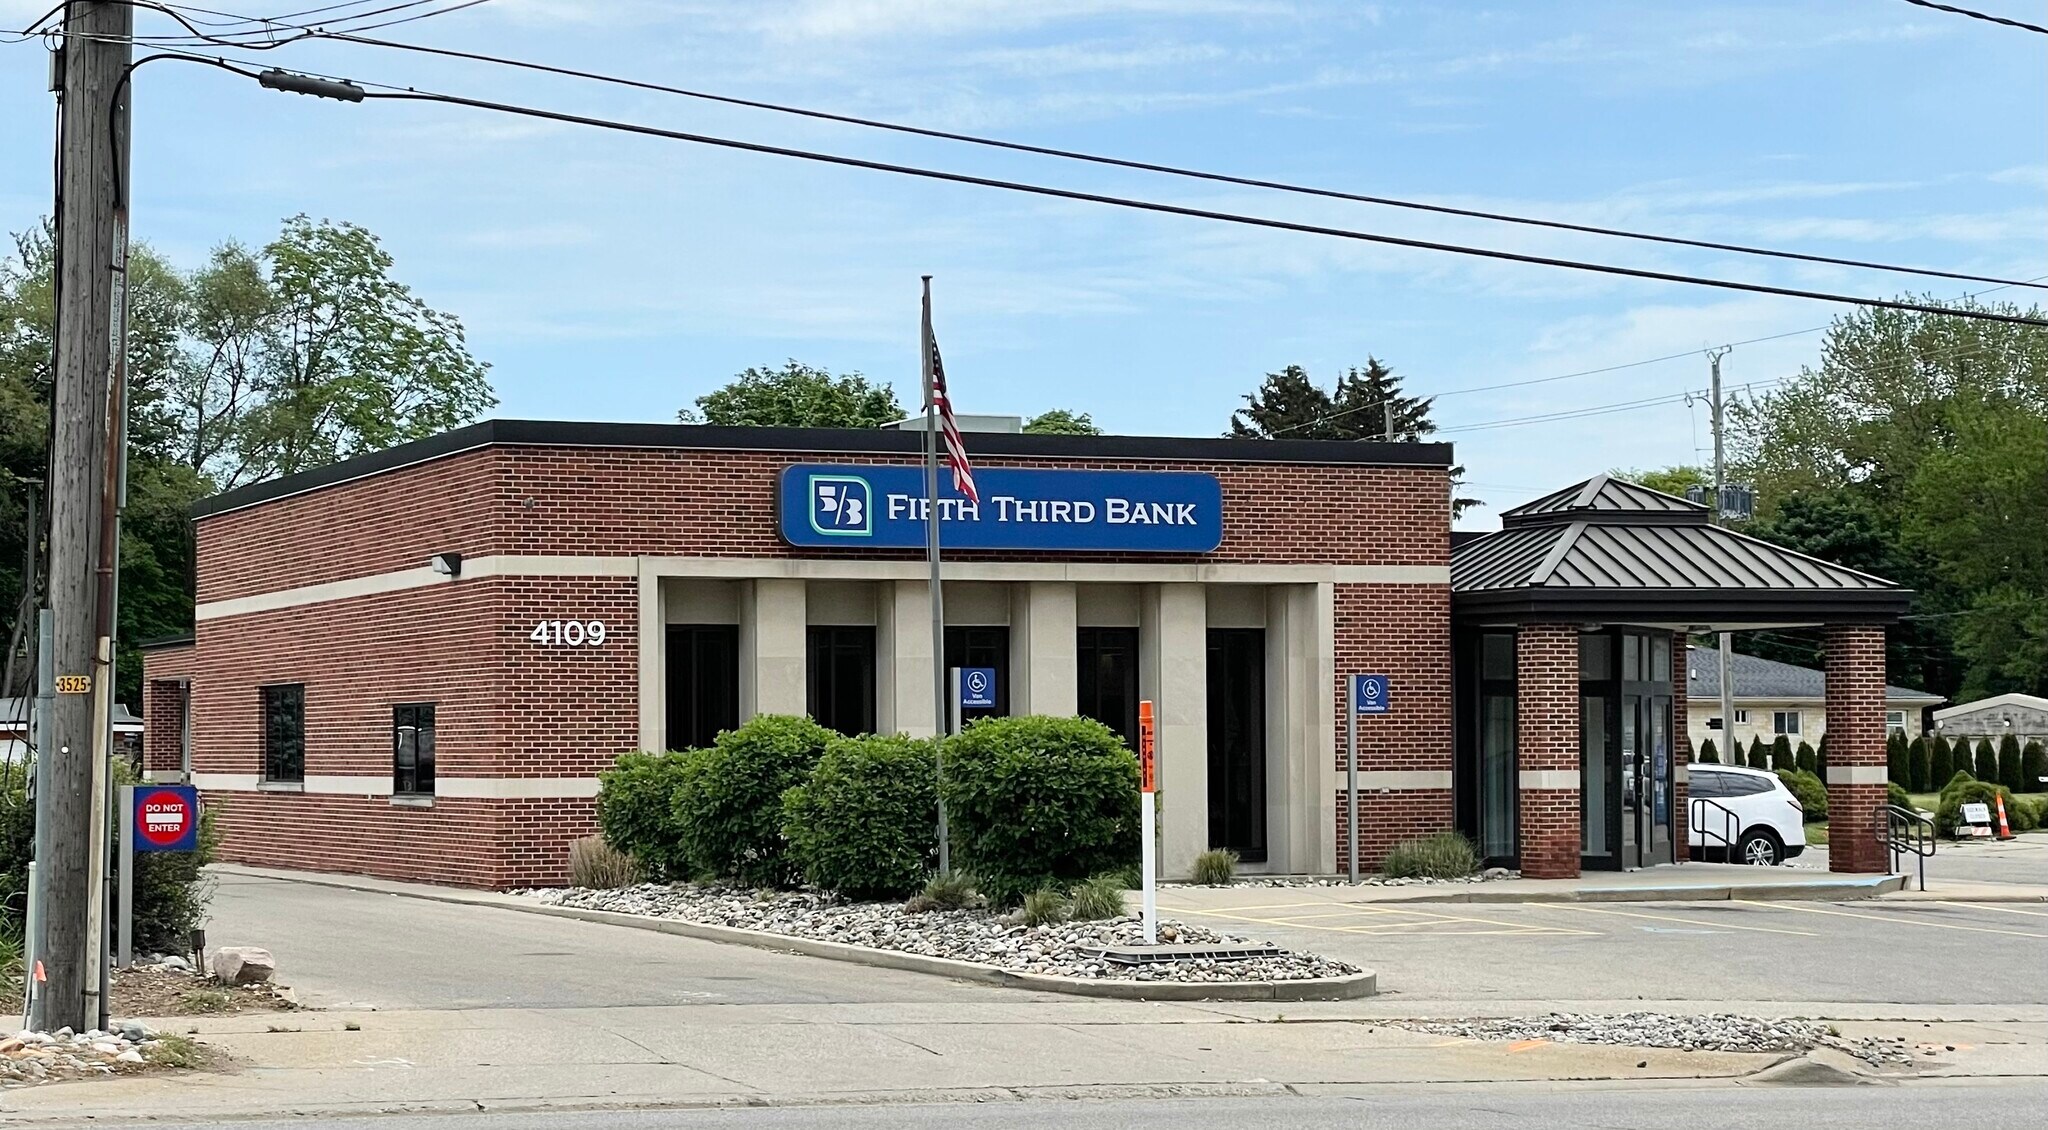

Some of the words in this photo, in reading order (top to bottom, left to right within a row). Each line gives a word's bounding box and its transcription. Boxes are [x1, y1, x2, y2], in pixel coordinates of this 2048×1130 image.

[991, 496, 1096, 523] THIRD
[1105, 498, 1198, 525] BANK
[529, 620, 606, 646] 4109
[59, 677, 87, 692] 3525
[145, 804, 161, 812] DO
[163, 803, 184, 812] NOT
[148, 824, 181, 832] ENTER
